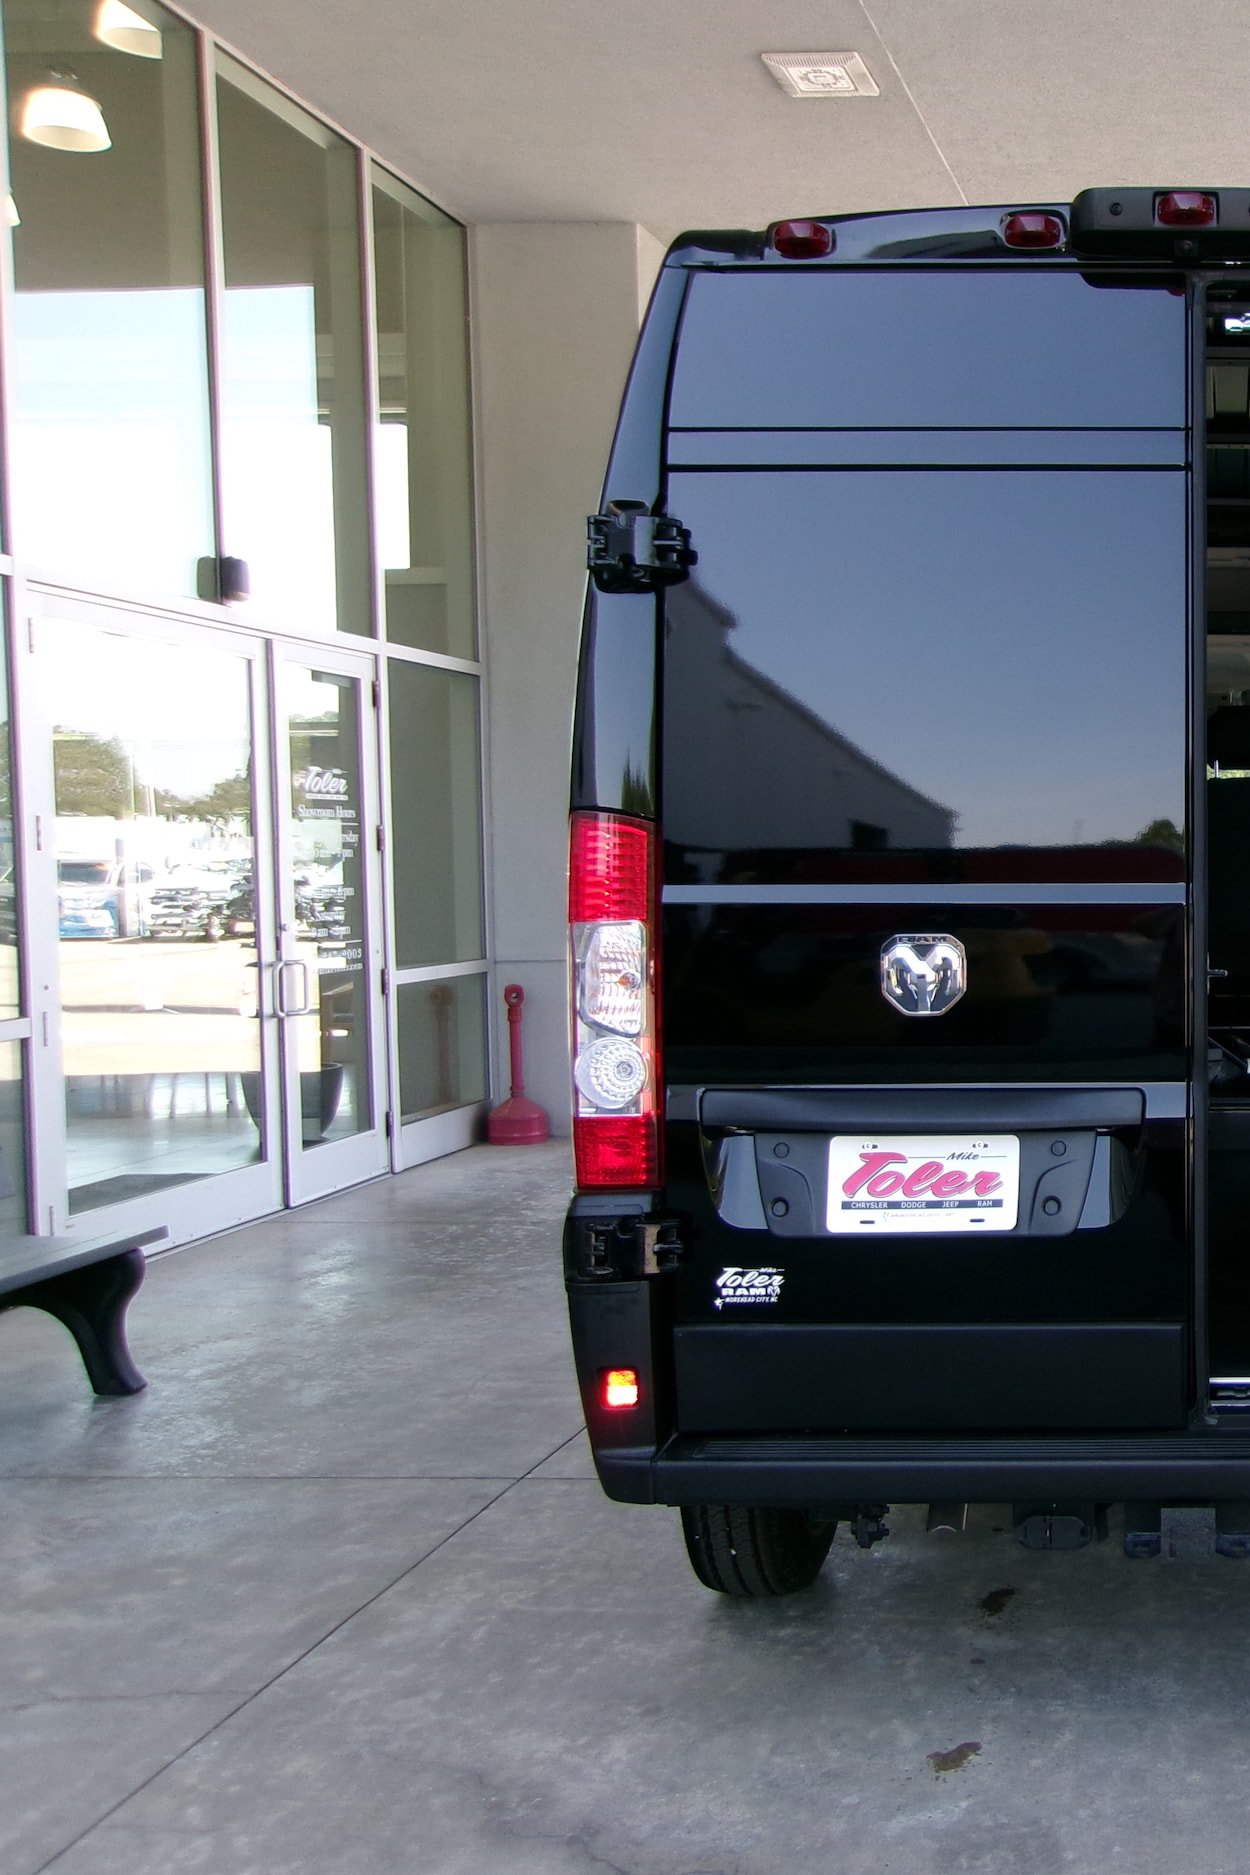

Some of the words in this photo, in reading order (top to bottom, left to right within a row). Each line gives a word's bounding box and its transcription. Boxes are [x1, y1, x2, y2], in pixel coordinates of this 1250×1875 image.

[305, 765, 348, 794] Toler
[946, 1152, 979, 1160] Mike
[842, 1152, 1004, 1198] Toler
[851, 1201, 888, 1209] CHRYSLER
[942, 1200, 960, 1208] JEEP
[717, 1267, 785, 1286] Toler
[722, 1288, 766, 1296] RAM
